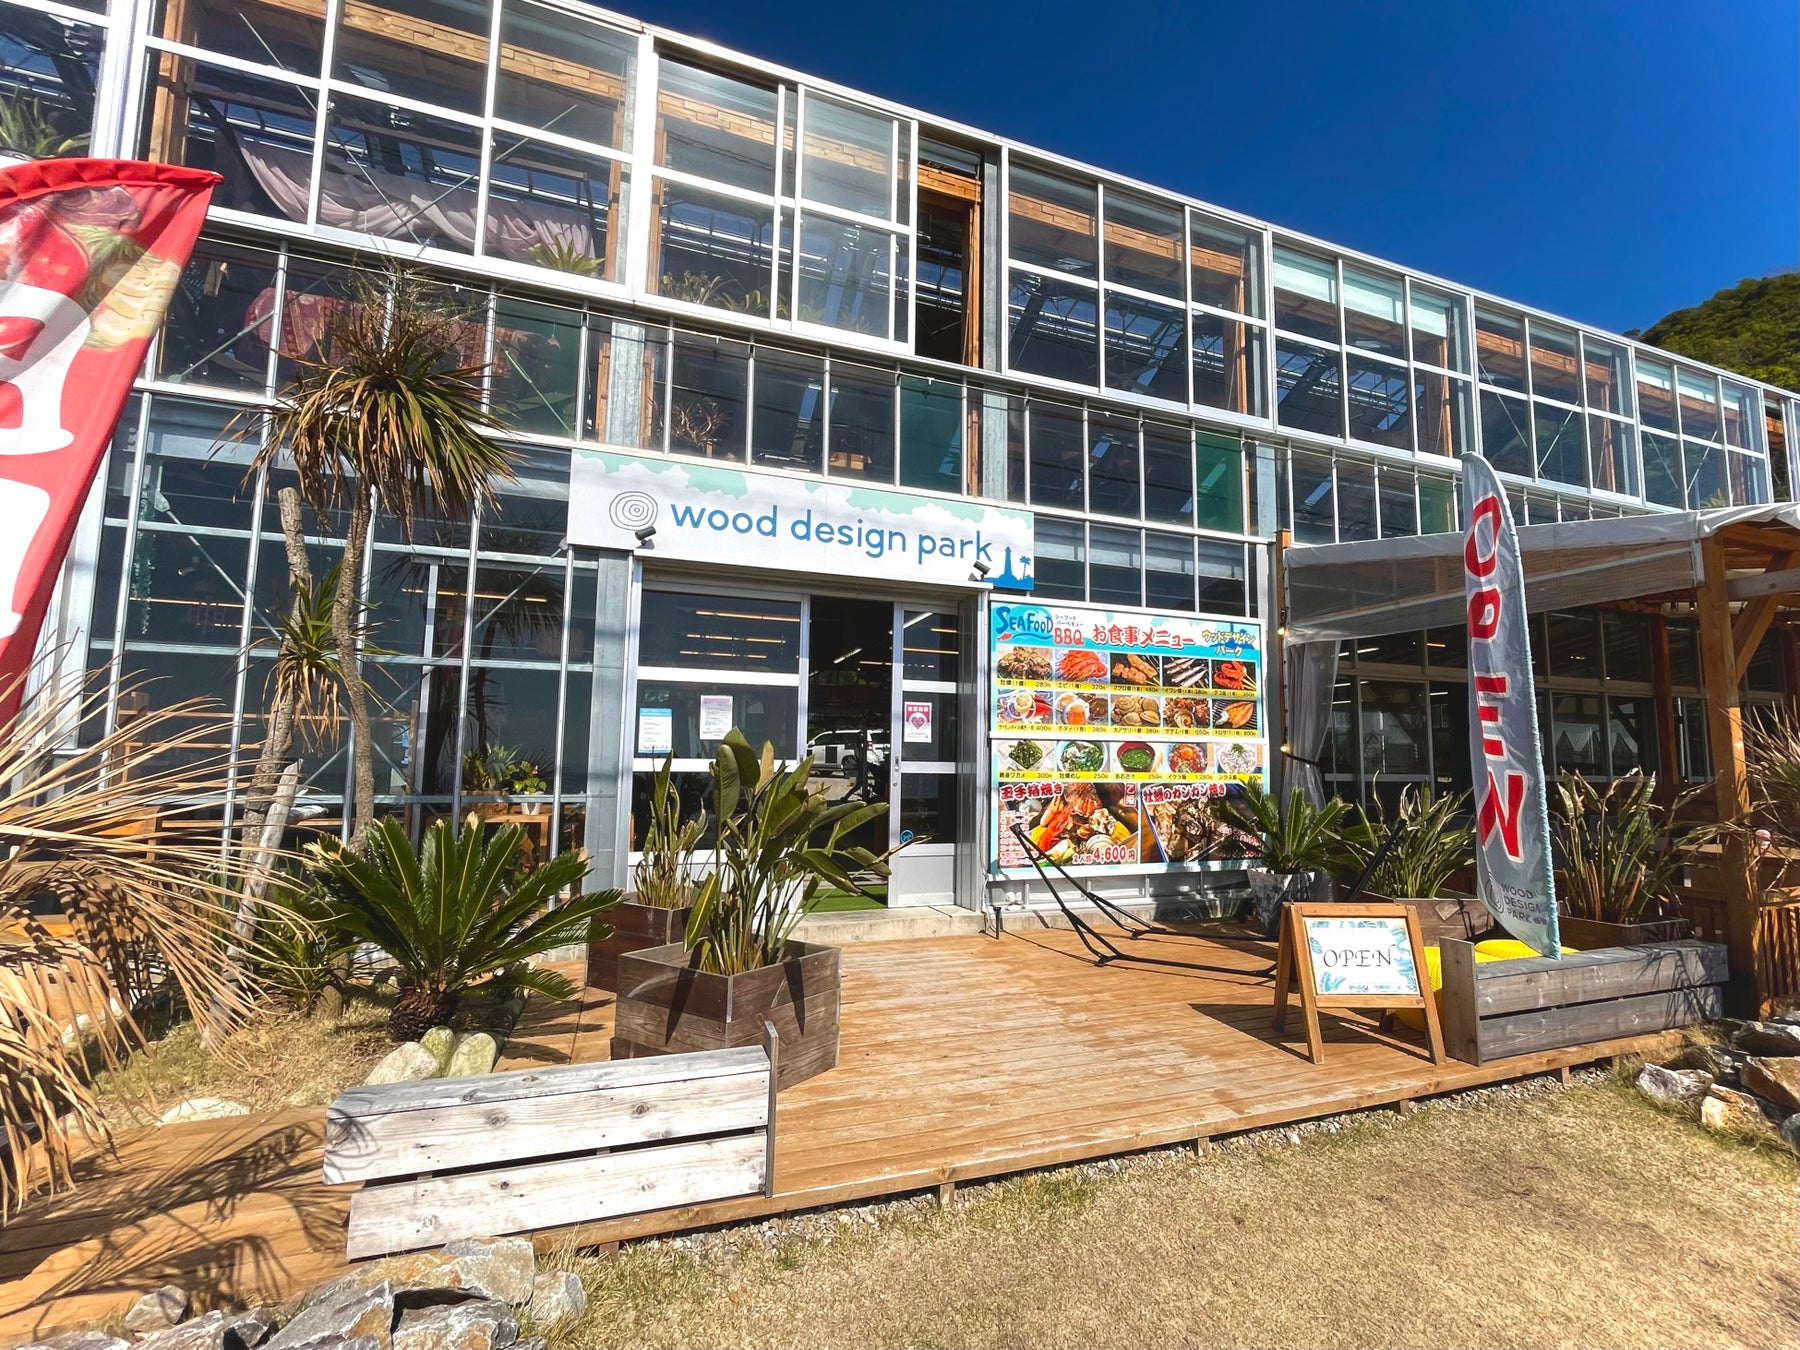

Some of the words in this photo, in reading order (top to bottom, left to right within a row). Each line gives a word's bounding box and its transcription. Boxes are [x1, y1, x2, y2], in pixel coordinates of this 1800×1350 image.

[669, 504, 778, 538] wood
[790, 508, 906, 559] design
[918, 530, 993, 565] park
[1054, 627, 1084, 646] BBQ
[1092, 624, 1195, 648] お食事メニュー
[1202, 629, 1256, 644] ウッドデザイン
[1215, 645, 1243, 658] パーク
[1465, 495, 1527, 864] OPEN
[1501, 882, 1534, 900] WOOD
[1504, 895, 1543, 914] DESIGN
[1323, 943, 1397, 968] OPEN
